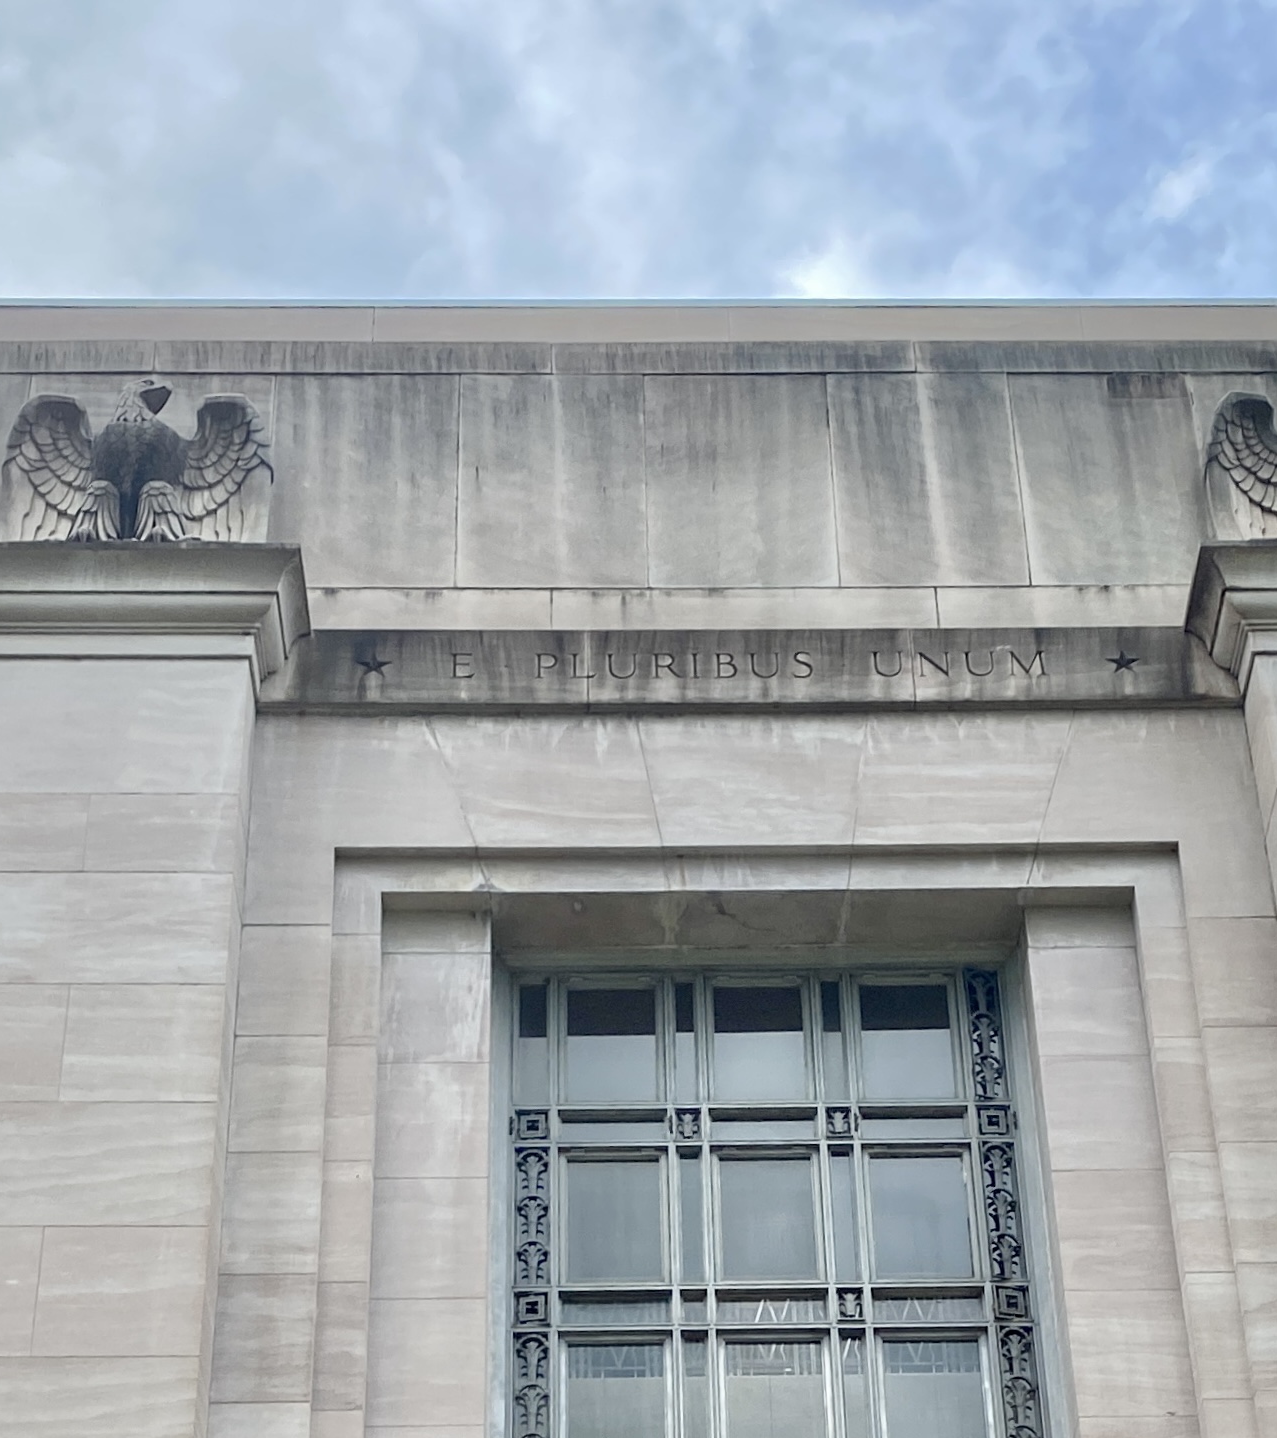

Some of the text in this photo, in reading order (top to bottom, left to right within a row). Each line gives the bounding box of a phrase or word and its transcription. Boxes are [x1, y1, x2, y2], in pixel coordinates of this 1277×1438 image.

[450, 648, 1050, 680] E PLURIBUS UNUM
